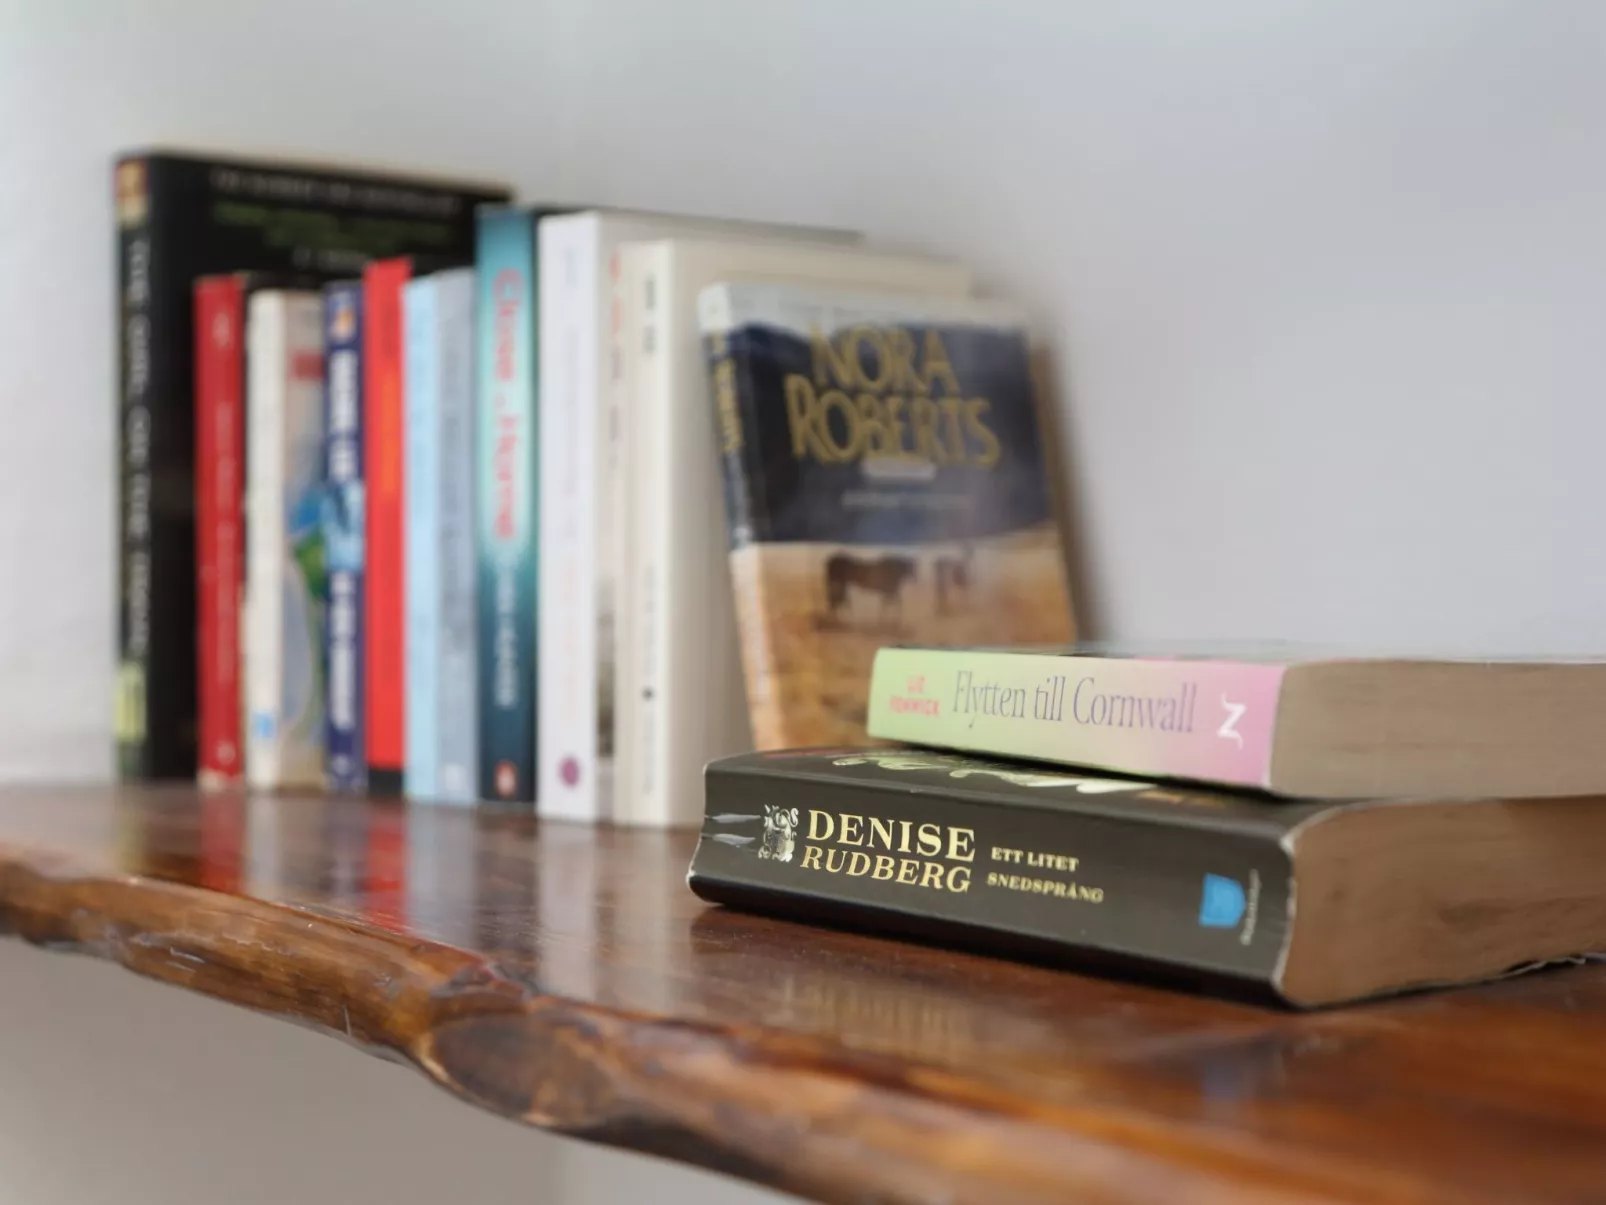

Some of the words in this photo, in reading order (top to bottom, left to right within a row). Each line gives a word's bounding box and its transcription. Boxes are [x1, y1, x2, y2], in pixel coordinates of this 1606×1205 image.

[811, 322, 961, 396] NORA
[784, 373, 1001, 468] ROBERTS
[953, 670, 1026, 729] Flytten
[1034, 675, 1066, 722] till
[1073, 676, 1198, 733] Cornwall
[806, 809, 976, 862] DENISE
[991, 847, 1023, 863] ETT
[1027, 852, 1079, 872] LITET
[800, 845, 972, 893] RUDBERG
[987, 872, 1104, 904] SNEDSPRÅNG
